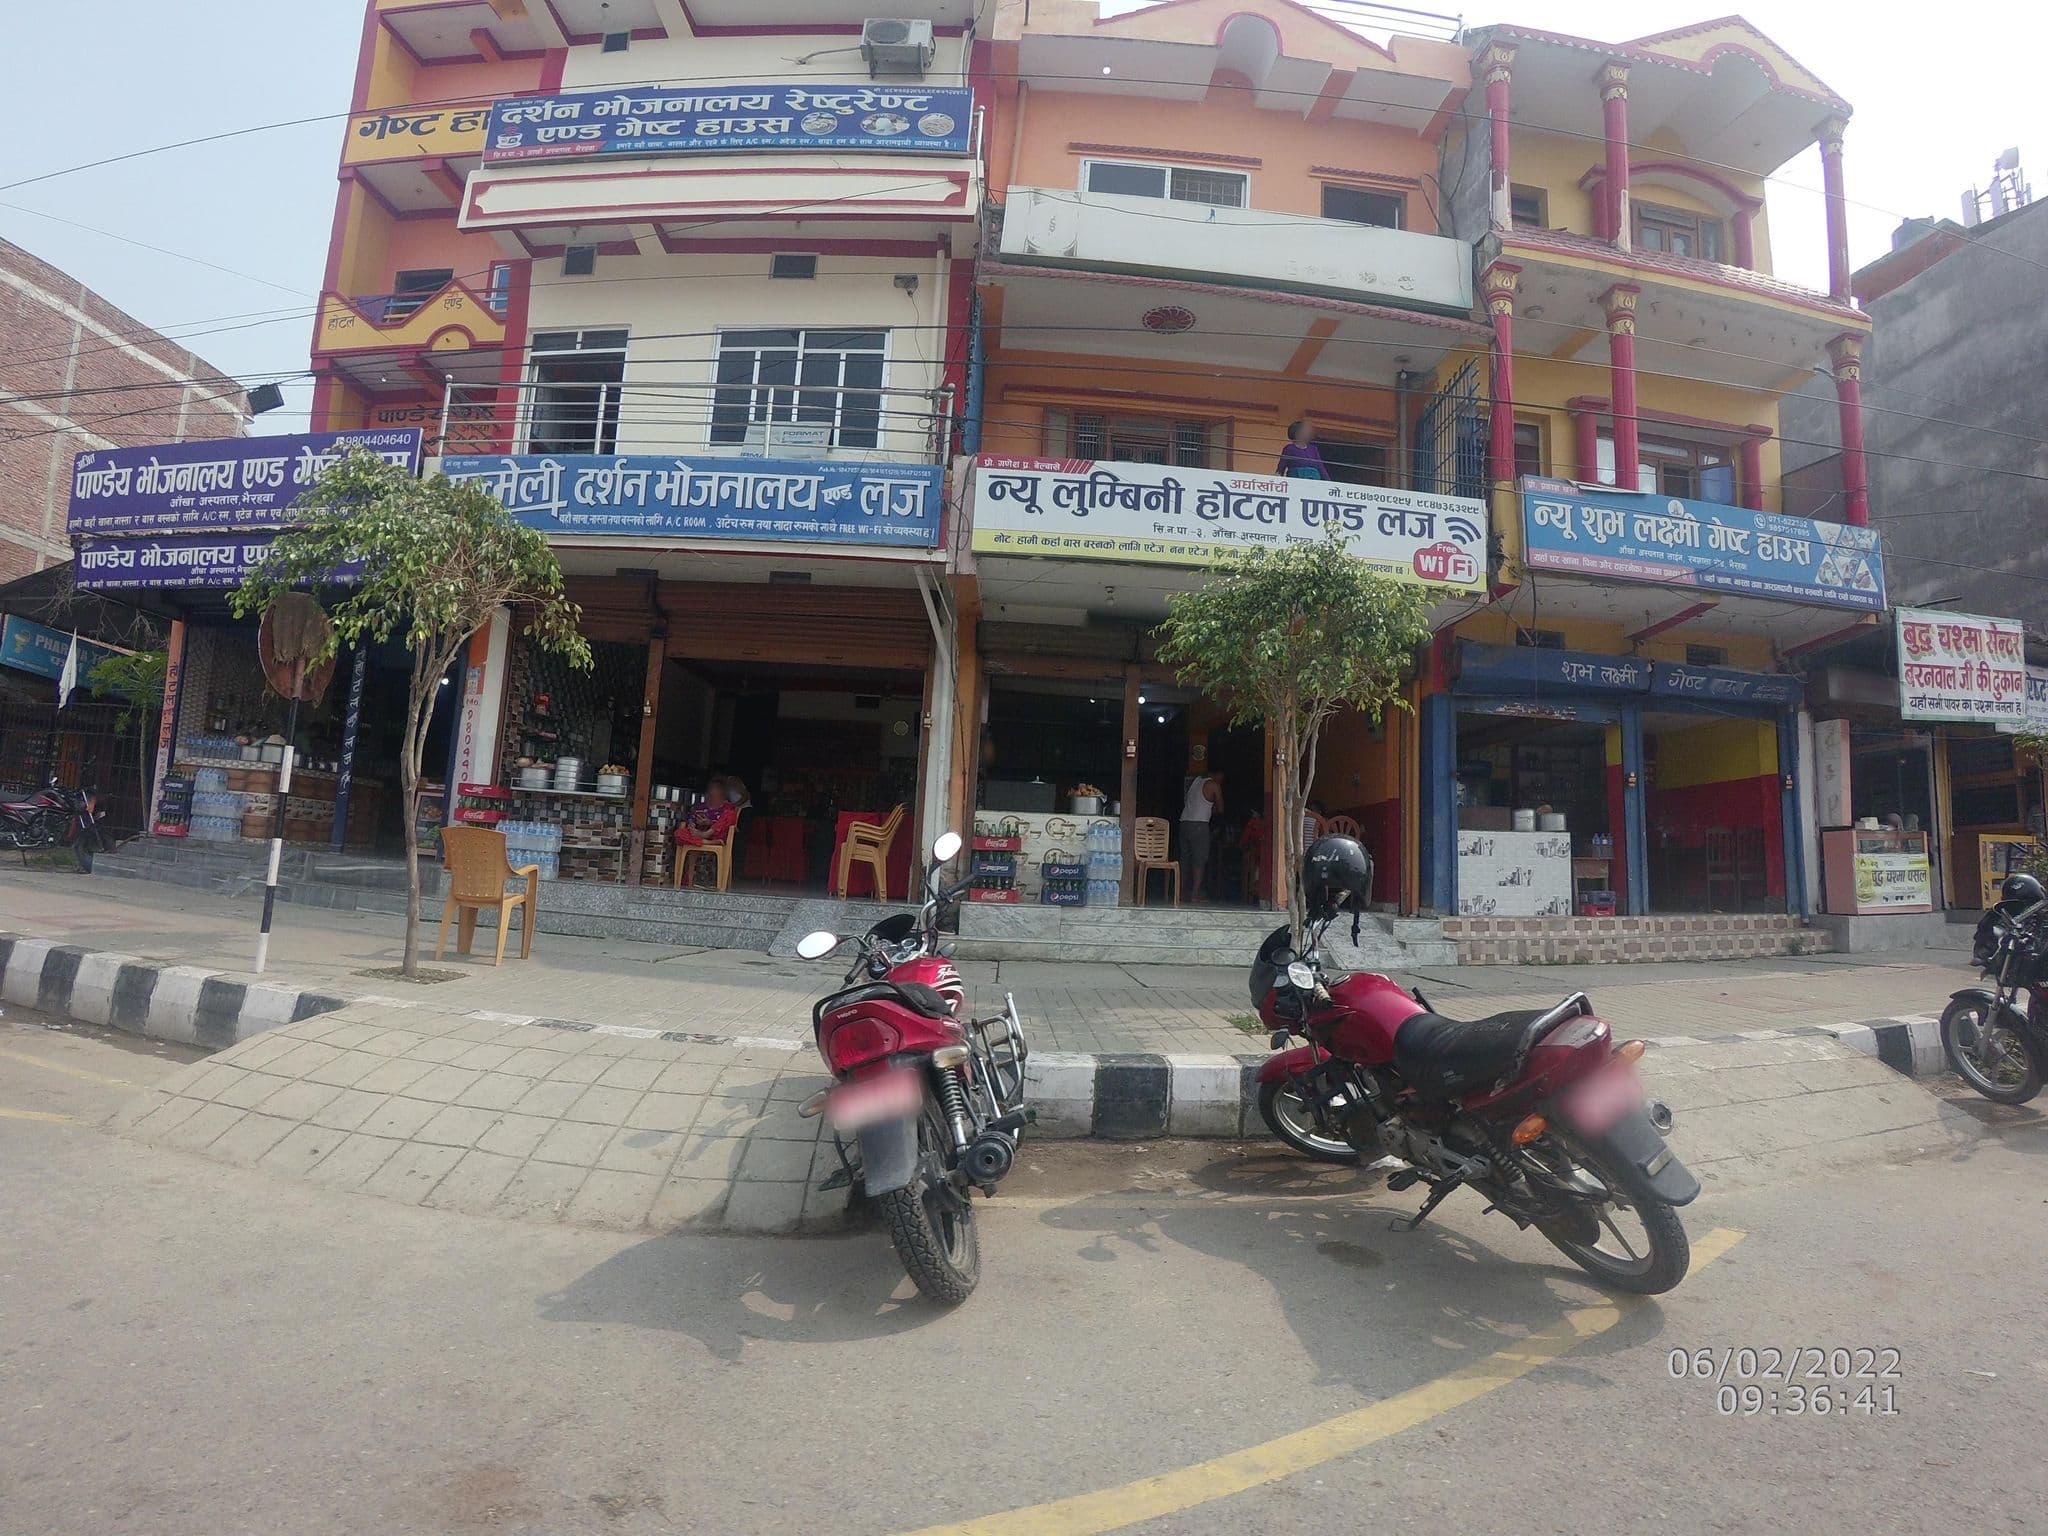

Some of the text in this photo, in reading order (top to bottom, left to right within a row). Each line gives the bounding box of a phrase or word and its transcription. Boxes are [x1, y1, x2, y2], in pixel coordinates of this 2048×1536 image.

[501, 101, 584, 124] दर्शन
[592, 94, 774, 118] भोजनालय
[536, 124, 606, 143] एण्ड
[695, 117, 794, 135] हाउस
[443, 296, 464, 311] एण्ड
[327, 314, 356, 332] होटल
[75, 456, 289, 499] पाण्डेय भोजनालय एण्ड
[574, 458, 652, 507] दर्शन
[655, 459, 825, 512] भोजनालय
[861, 477, 931, 518] लज
[202, 510, 216, 521] A/C
[988, 471, 1437, 539] न्यू लुम्बिनी होटल एण्ड लज
[684, 517, 706, 527] ROOM
[840, 524, 856, 533] FREE
[1533, 500, 1578, 541] न्यू
[1581, 506, 1626, 544] शुभ
[1707, 517, 1751, 555] गेष्ट
[1757, 532, 1811, 566] हाउस
[1017, 534, 1038, 545] हामी
[1437, 543, 1457, 554] Free
[80, 543, 237, 568] पाण्डेय भोजनालय
[1561, 661, 1638, 687] शुभ लक्ष्मी
[1959, 659, 1974, 692] जी
[1976, 660, 1991, 692] की
[1993, 669, 2023, 701] दुकान
